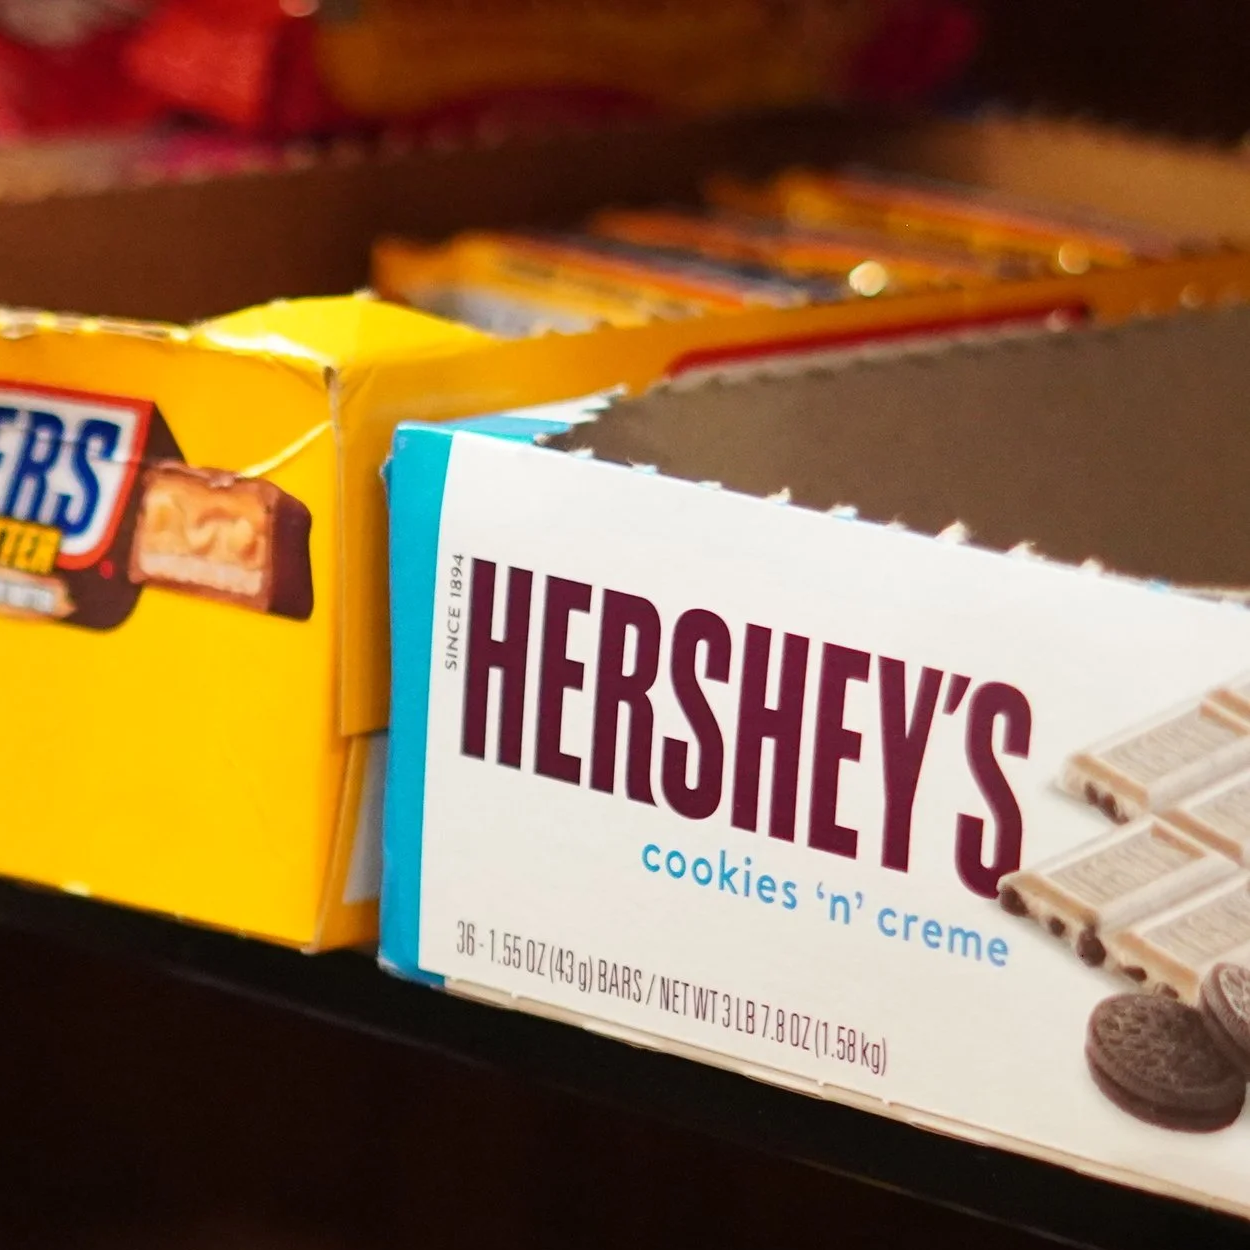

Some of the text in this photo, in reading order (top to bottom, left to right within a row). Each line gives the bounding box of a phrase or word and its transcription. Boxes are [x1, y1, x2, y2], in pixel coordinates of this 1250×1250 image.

[445, 553, 465, 671] SINCE 1894
[461, 557, 1034, 900] HERSHEY'S
[640, 841, 799, 911] cookies
[876, 906, 1010, 968] creme
[456, 920, 475, 956] 36
[489, 928, 522, 969] 1.55
[597, 958, 643, 1004] BARS
[659, 975, 690, 1017] NET
[722, 993, 731, 1029] 3
[736, 996, 756, 1035] LB
[761, 1003, 786, 1045] 7.8
[790, 1011, 811, 1052] OZ
